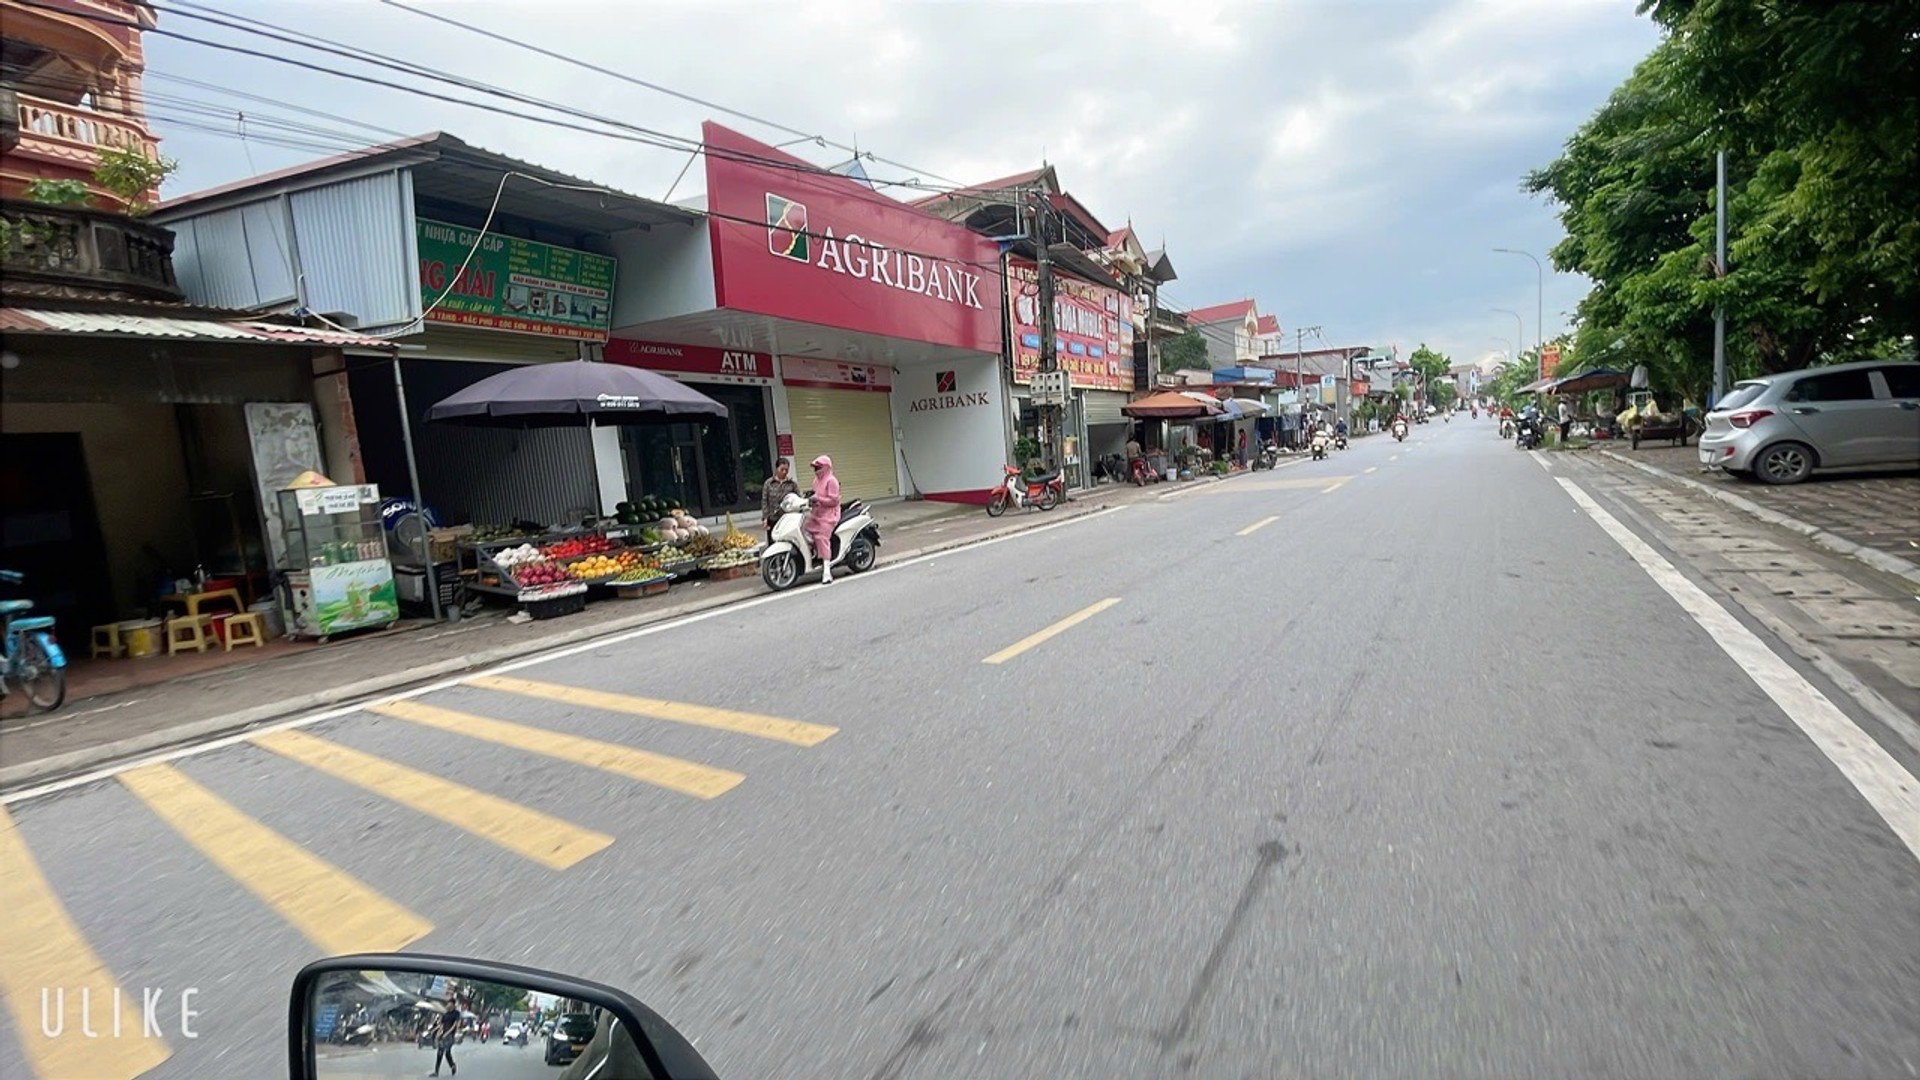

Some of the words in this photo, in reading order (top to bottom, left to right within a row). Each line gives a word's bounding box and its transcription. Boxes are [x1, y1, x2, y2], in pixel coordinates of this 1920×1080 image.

[425, 225, 456, 244] NHỰA
[483, 235, 503, 253] CẤP
[452, 256, 496, 299] HẢI
[817, 226, 983, 310] AGRIBANK
[721, 351, 757, 371] ATM
[910, 392, 989, 412] AGRIBANK
